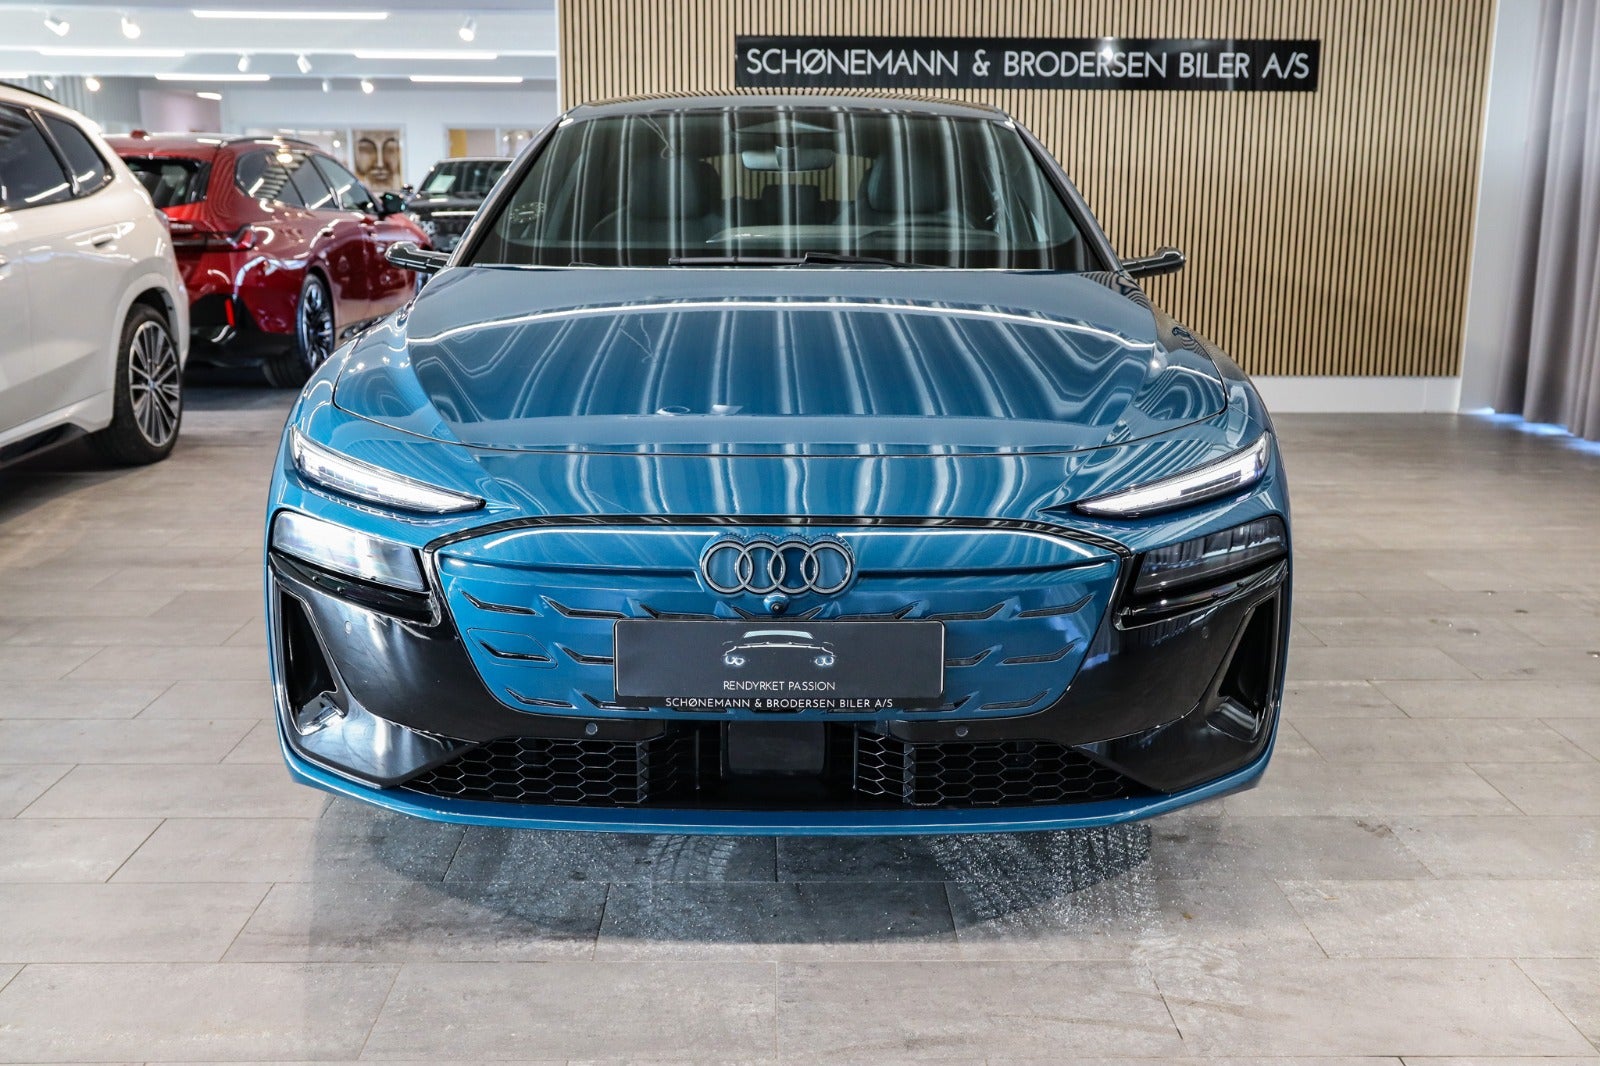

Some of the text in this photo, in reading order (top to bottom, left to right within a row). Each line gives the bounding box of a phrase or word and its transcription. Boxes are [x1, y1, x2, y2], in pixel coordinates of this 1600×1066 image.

[746, 48, 1310, 80] SCHØNEMANN & BRODERSEN BILER A/S
[723, 680, 836, 691] RENDYRKET PASSION
[665, 697, 893, 709] SCHØNEMANN & BRODERSEN BILER A/S
